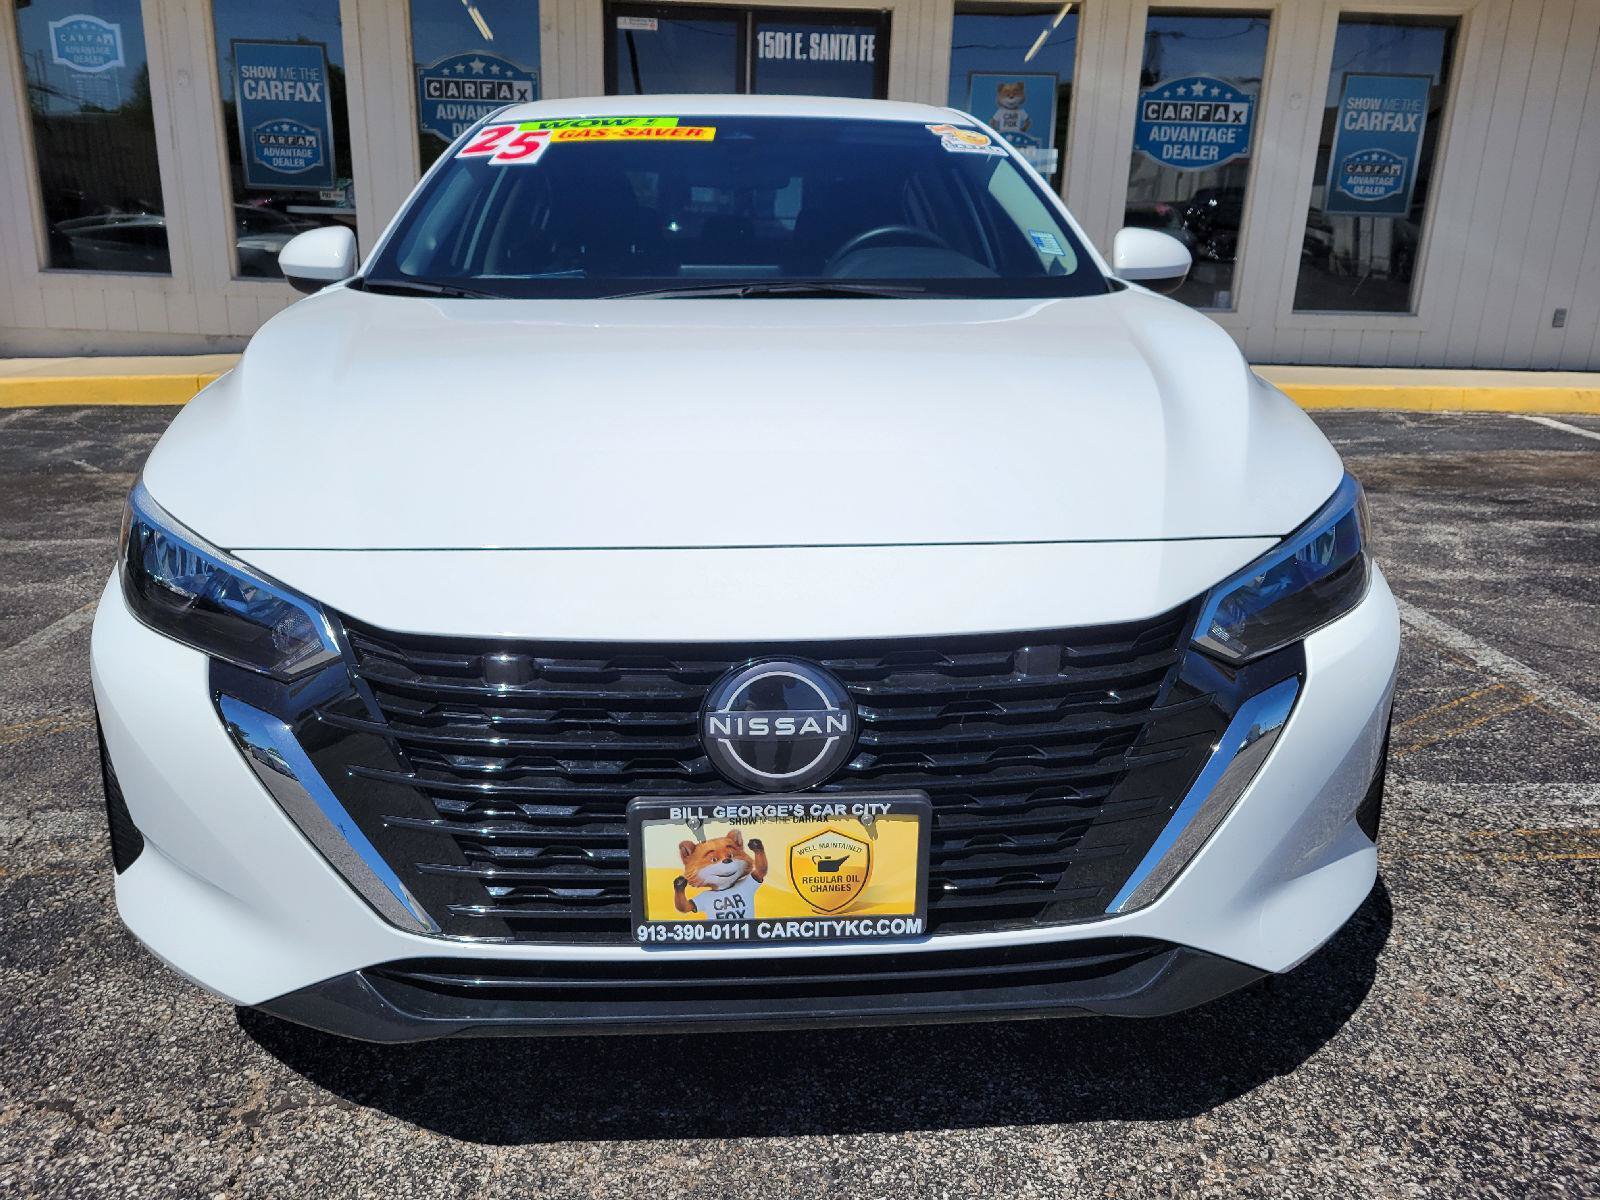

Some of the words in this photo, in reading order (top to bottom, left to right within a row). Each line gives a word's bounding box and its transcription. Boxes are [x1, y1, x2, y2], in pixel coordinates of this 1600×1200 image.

[757, 31, 792, 59] 1501
[795, 33, 807, 60] E.
[809, 33, 856, 61] SANTA
[860, 34, 875, 62] FE
[241, 65, 277, 79] SHOW
[280, 67, 297, 80] ME
[299, 68, 320, 81] THE
[242, 79, 322, 102] CARFAX
[429, 81, 529, 103] CARFAX
[1346, 97, 1381, 110] SHOW
[1383, 98, 1400, 111] ME
[1401, 98, 1421, 112] THE
[1146, 103, 1244, 123] CARFAX
[539, 119, 637, 129] WOW
[1344, 111, 1419, 132] CARFAX
[259, 135, 318, 148] CARFAX
[1149, 126, 1236, 143] ADVANTAGE
[461, 126, 550, 160] 25
[263, 147, 313, 158] ADVANTAGE
[1162, 144, 1219, 160] DEALER
[272, 157, 306, 167] DEALER
[1347, 176, 1394, 186] ADVANTAGE
[1353, 186, 1386, 195] DEALER
[709, 714, 847, 736] NISSAN
[669, 806, 709, 820] BILL
[712, 803, 805, 818] GEORGE'S
[809, 803, 847, 817] CAR
[851, 803, 891, 816] CITY
[729, 816, 757, 826] SHOW
[797, 845, 817, 855] WELL
[818, 842, 863, 854] MAINTAINED
[802, 875, 843, 884] REGULAR
[846, 874, 860, 883] OIL
[810, 883, 852, 893] CHANGES
[713, 894, 746, 911] CAR
[637, 923, 750, 941] 913-390-0111
[757, 918, 922, 939] CARCITYKC.COM
